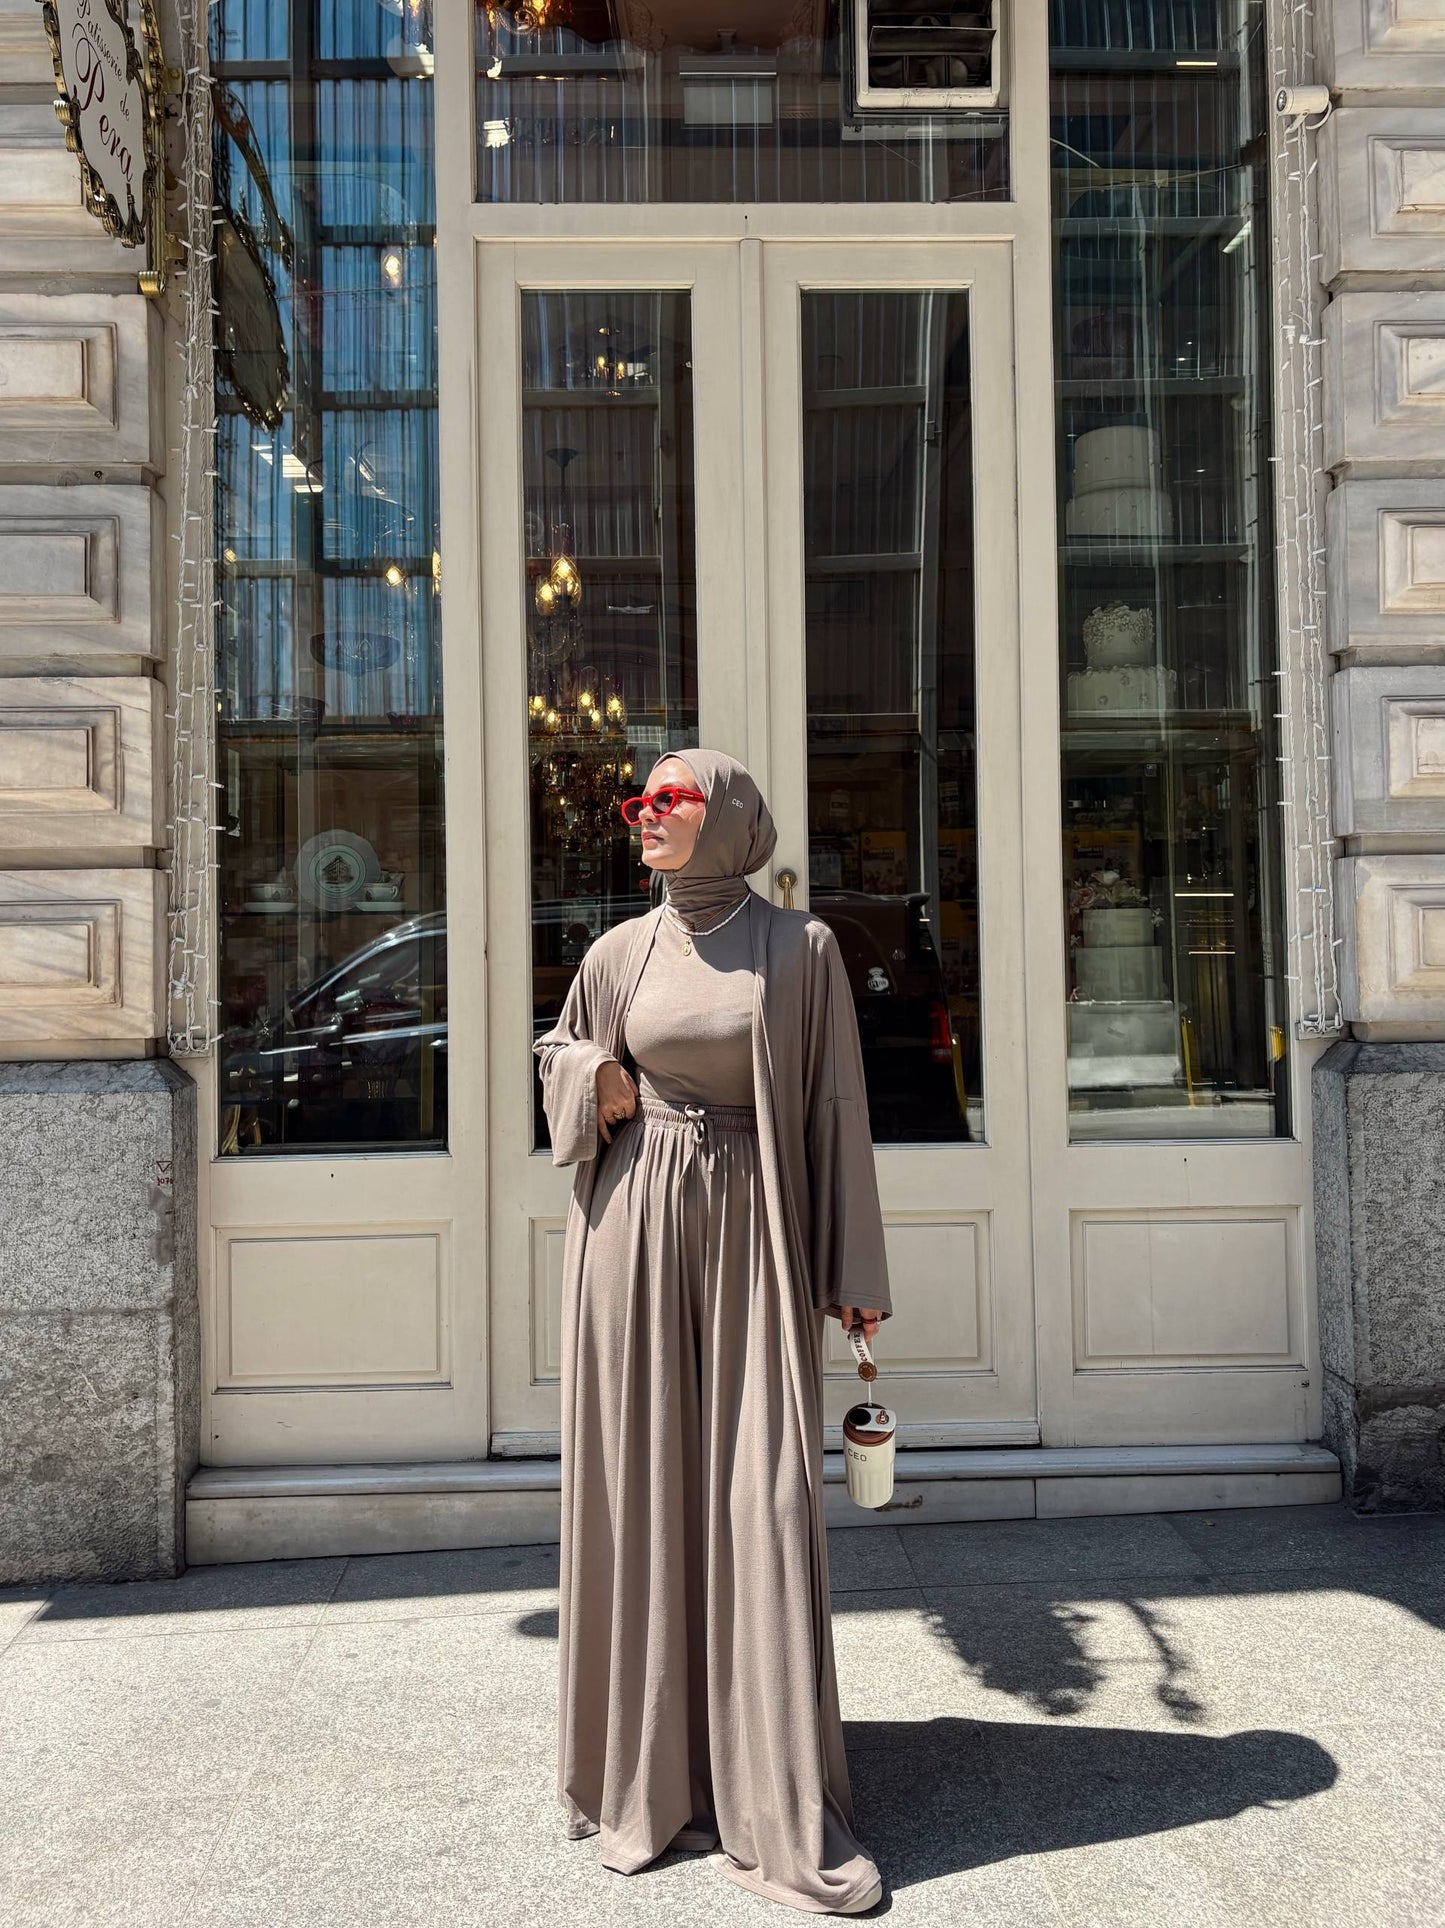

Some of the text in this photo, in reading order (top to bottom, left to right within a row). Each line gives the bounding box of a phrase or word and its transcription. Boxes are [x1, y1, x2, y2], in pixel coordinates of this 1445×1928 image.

[72, 22, 133, 182] Pera
[119, 92, 130, 122] de
[731, 798, 744, 809] CEO
[853, 1331, 868, 1362] COFFEE
[847, 1447, 867, 1462] CEO
